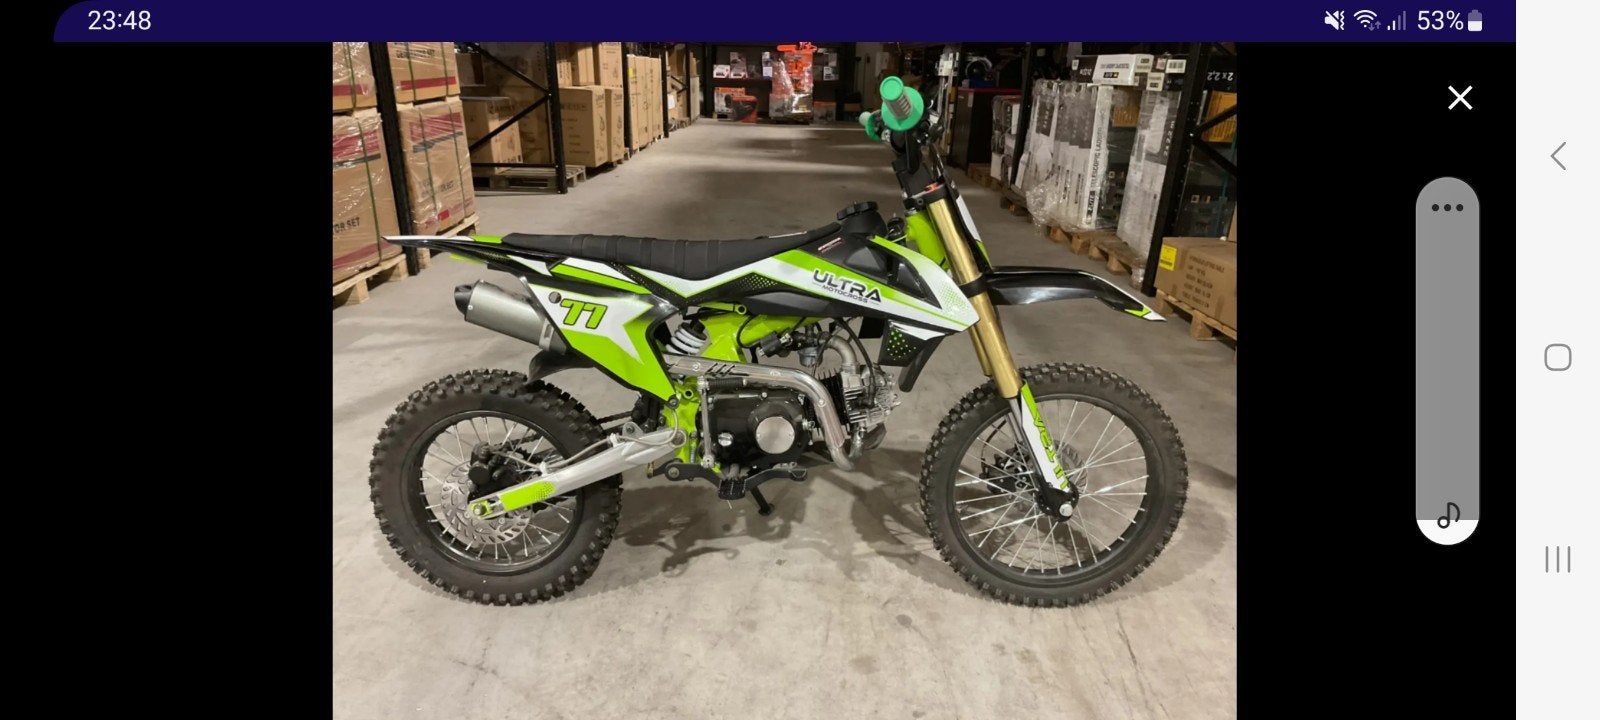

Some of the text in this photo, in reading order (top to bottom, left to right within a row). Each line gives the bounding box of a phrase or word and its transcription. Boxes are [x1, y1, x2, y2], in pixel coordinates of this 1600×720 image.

[346, 216, 360, 230] SET
[813, 269, 882, 303] ULTRA
[822, 285, 868, 303] MOTOCROSS
[560, 297, 608, 330] 77
